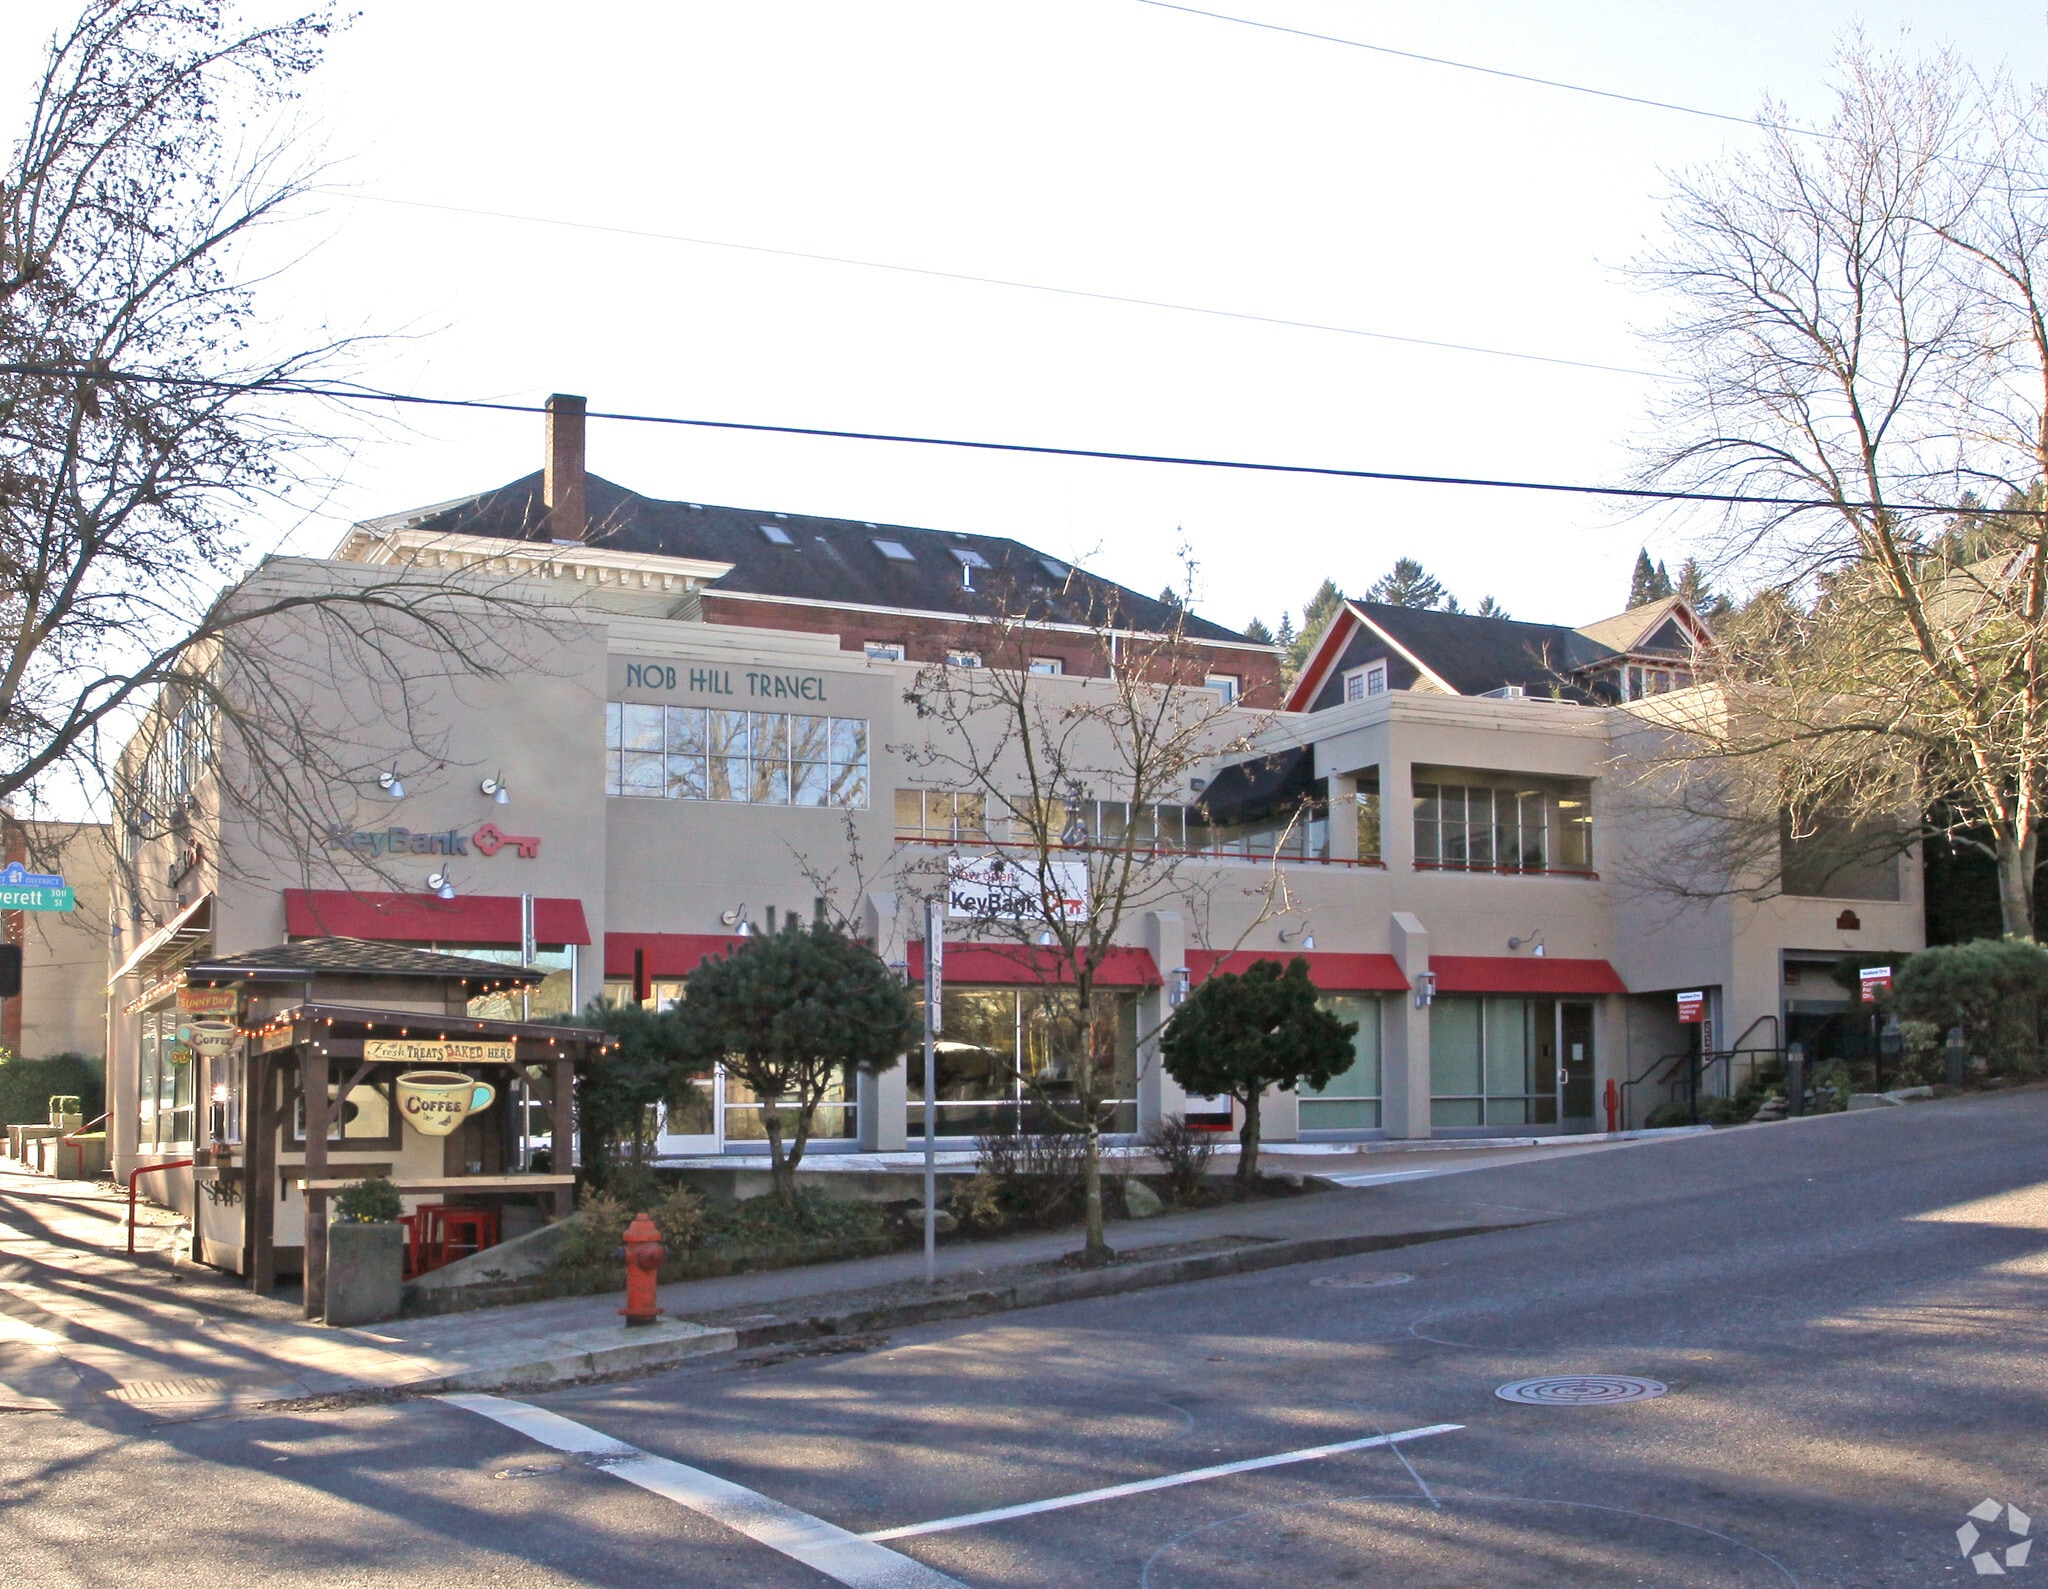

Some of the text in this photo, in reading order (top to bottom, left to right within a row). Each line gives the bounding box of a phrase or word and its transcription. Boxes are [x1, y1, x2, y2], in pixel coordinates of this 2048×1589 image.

[627, 663, 827, 701] NOB HILL TRAVEL
[329, 823, 469, 857] KeyBank
[25, 877, 59, 885] DISTRICT
[951, 891, 1037, 913] KeyBank
[181, 996, 229, 1008] SUNNY DAY
[194, 1033, 234, 1046] COFFEE
[367, 1041, 512, 1061] Fresh TREATS BAKED HERE
[405, 1096, 462, 1114] COFFEE
